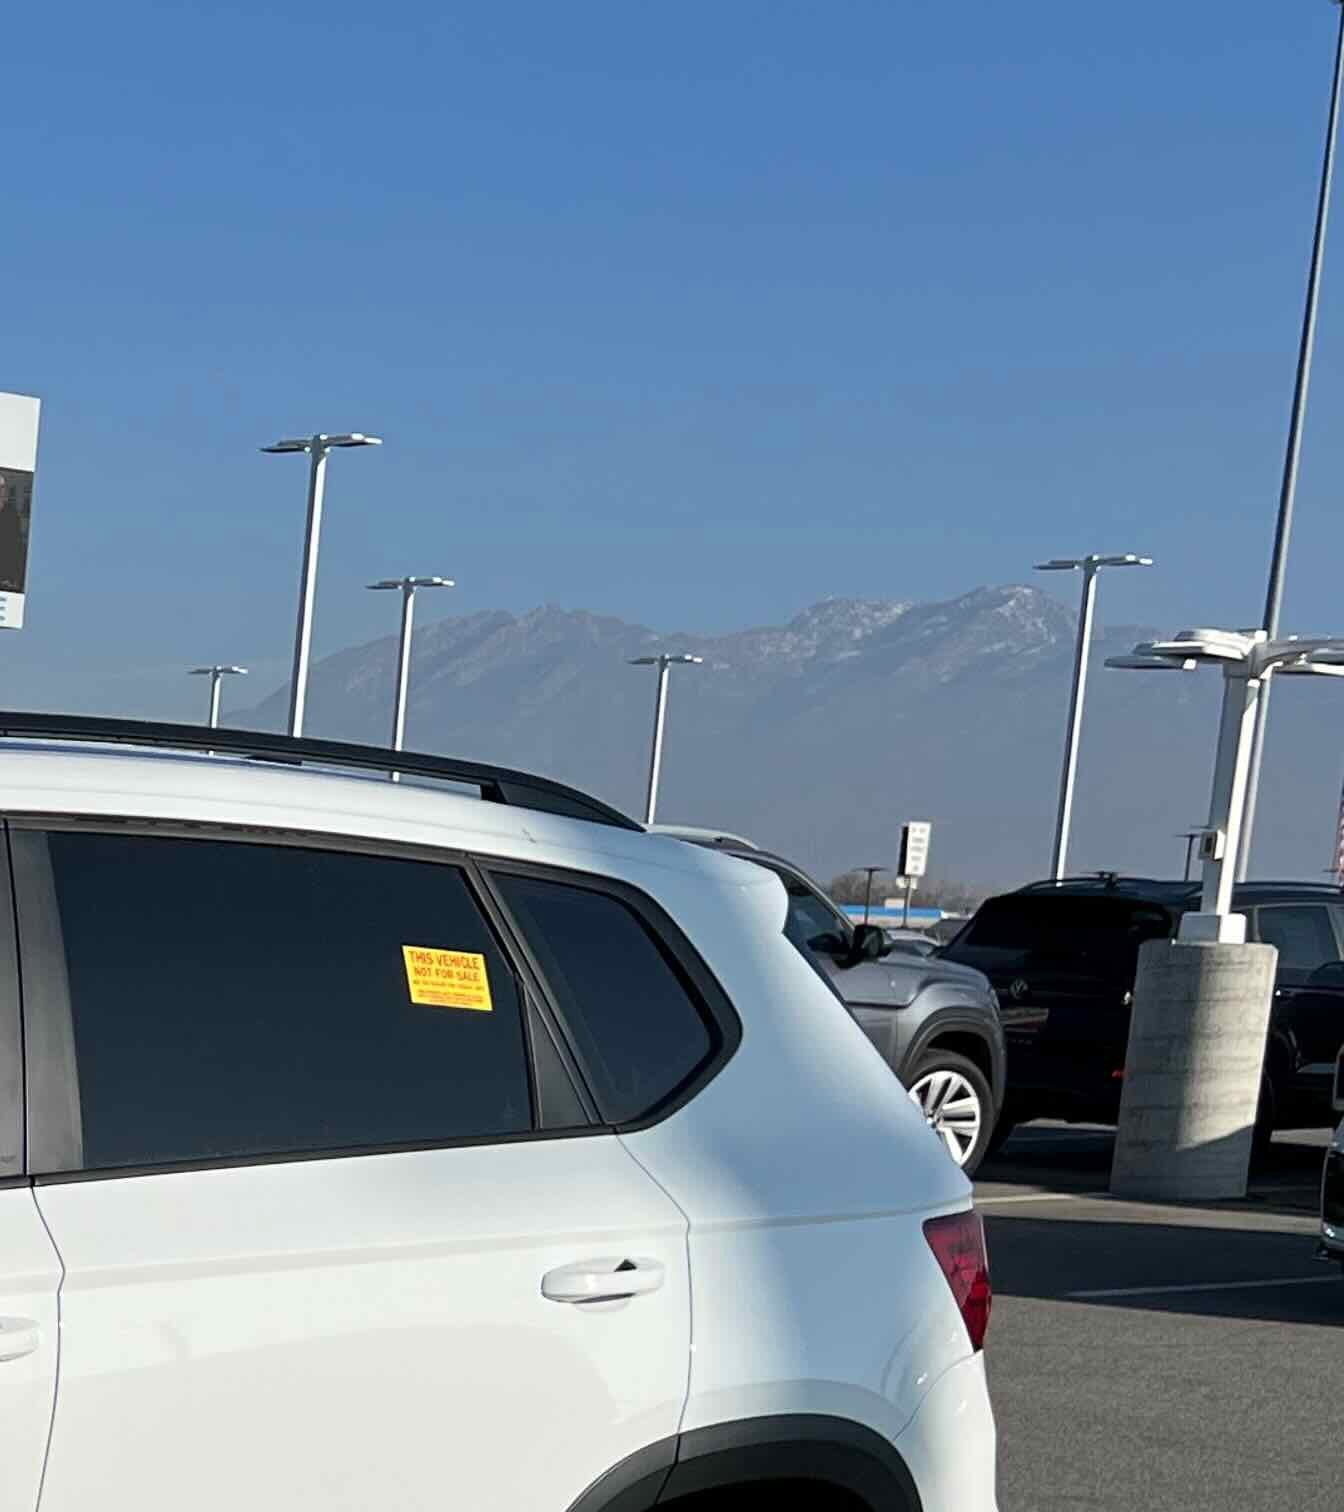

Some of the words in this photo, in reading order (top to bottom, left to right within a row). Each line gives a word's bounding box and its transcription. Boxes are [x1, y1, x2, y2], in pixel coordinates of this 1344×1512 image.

[408, 950, 433, 966] THIS
[434, 953, 481, 970] VEHICLE
[413, 966, 432, 977] NOT
[435, 967, 454, 979] FOR
[455, 970, 481, 981] SALE
